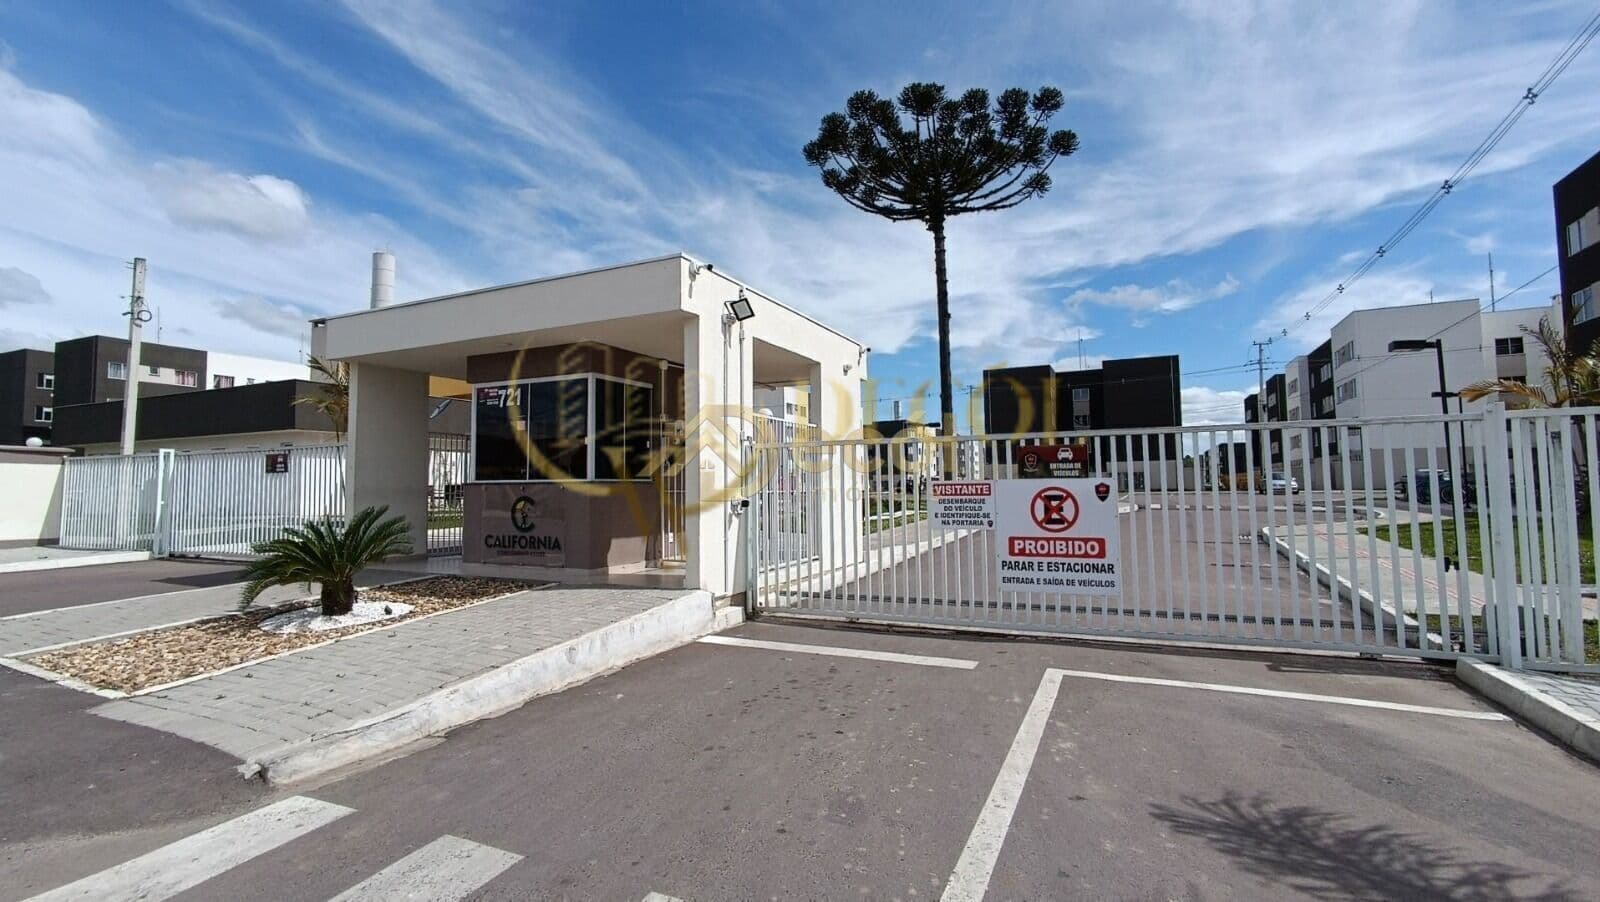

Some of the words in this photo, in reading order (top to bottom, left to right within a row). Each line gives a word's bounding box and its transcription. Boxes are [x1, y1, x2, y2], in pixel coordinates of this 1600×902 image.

[498, 388, 521, 408] 721
[934, 484, 990, 495] VISITANTE
[484, 534, 562, 551] CALIFORNIA
[1013, 540, 1100, 556] PROIBIDO
[1001, 560, 1035, 572] PARAR
[1037, 561, 1044, 572] E
[1047, 562, 1115, 575] ESTACIONAR
[1002, 576, 1035, 585] ENTRADA
[1036, 578, 1041, 586] E
[1042, 577, 1065, 587] SAÍDA
[1066, 579, 1076, 587] DE
[1077, 578, 1116, 588] VEÍCULOS
